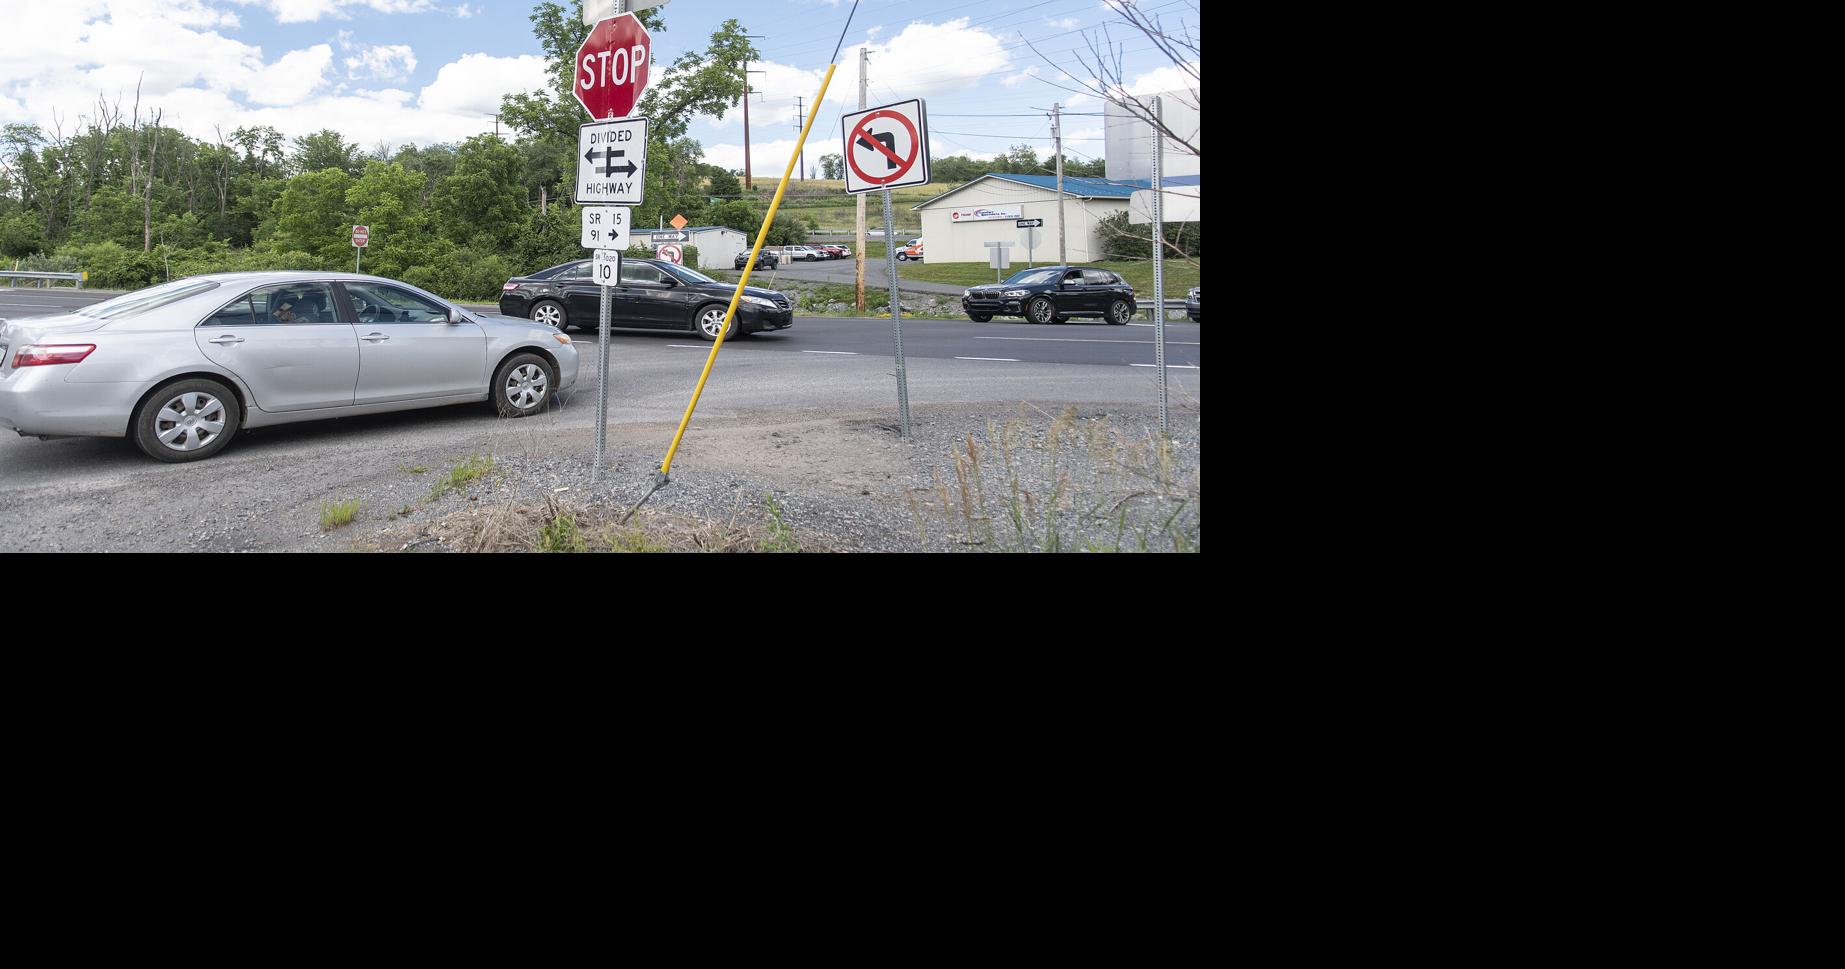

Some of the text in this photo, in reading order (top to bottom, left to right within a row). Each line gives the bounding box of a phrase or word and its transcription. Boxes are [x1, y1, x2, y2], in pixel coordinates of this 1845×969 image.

[580, 45, 646, 90] STOP
[590, 129, 633, 144] DIVIDED
[586, 182, 633, 194] HIGHWAY
[589, 213, 622, 225] SR 15
[590, 229, 600, 241] 91
[600, 264, 611, 279] 10
